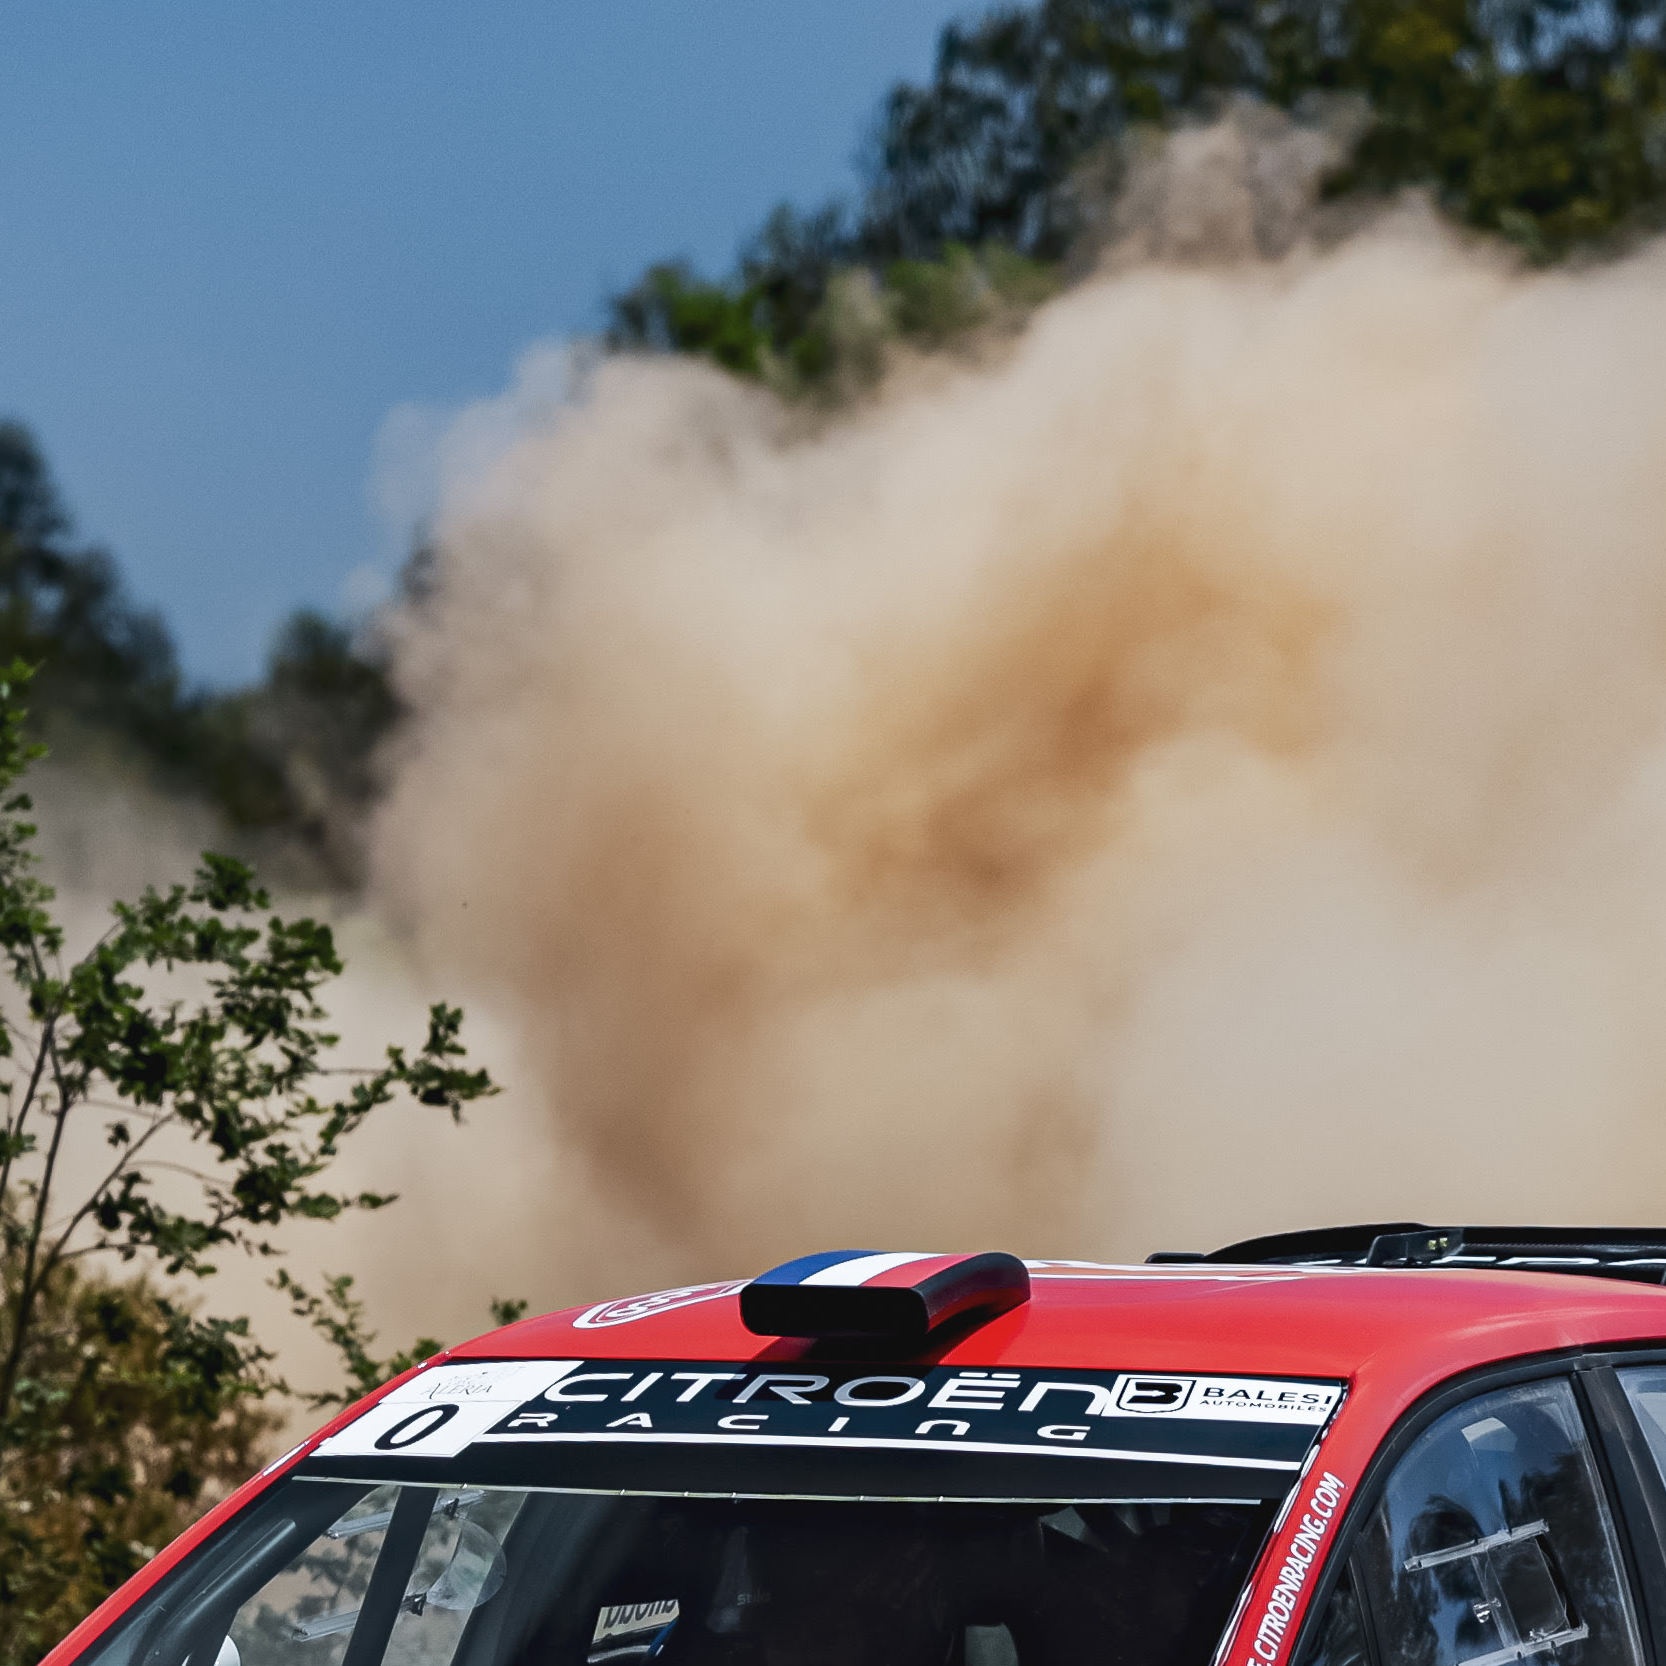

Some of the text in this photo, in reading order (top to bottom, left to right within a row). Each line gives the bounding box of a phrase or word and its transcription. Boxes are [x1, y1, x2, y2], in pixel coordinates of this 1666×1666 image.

[1202, 1386, 1333, 1404] BALESI
[1199, 1398, 1327, 1412] AUTOMOBILES
[374, 1404, 460, 1450] 0
